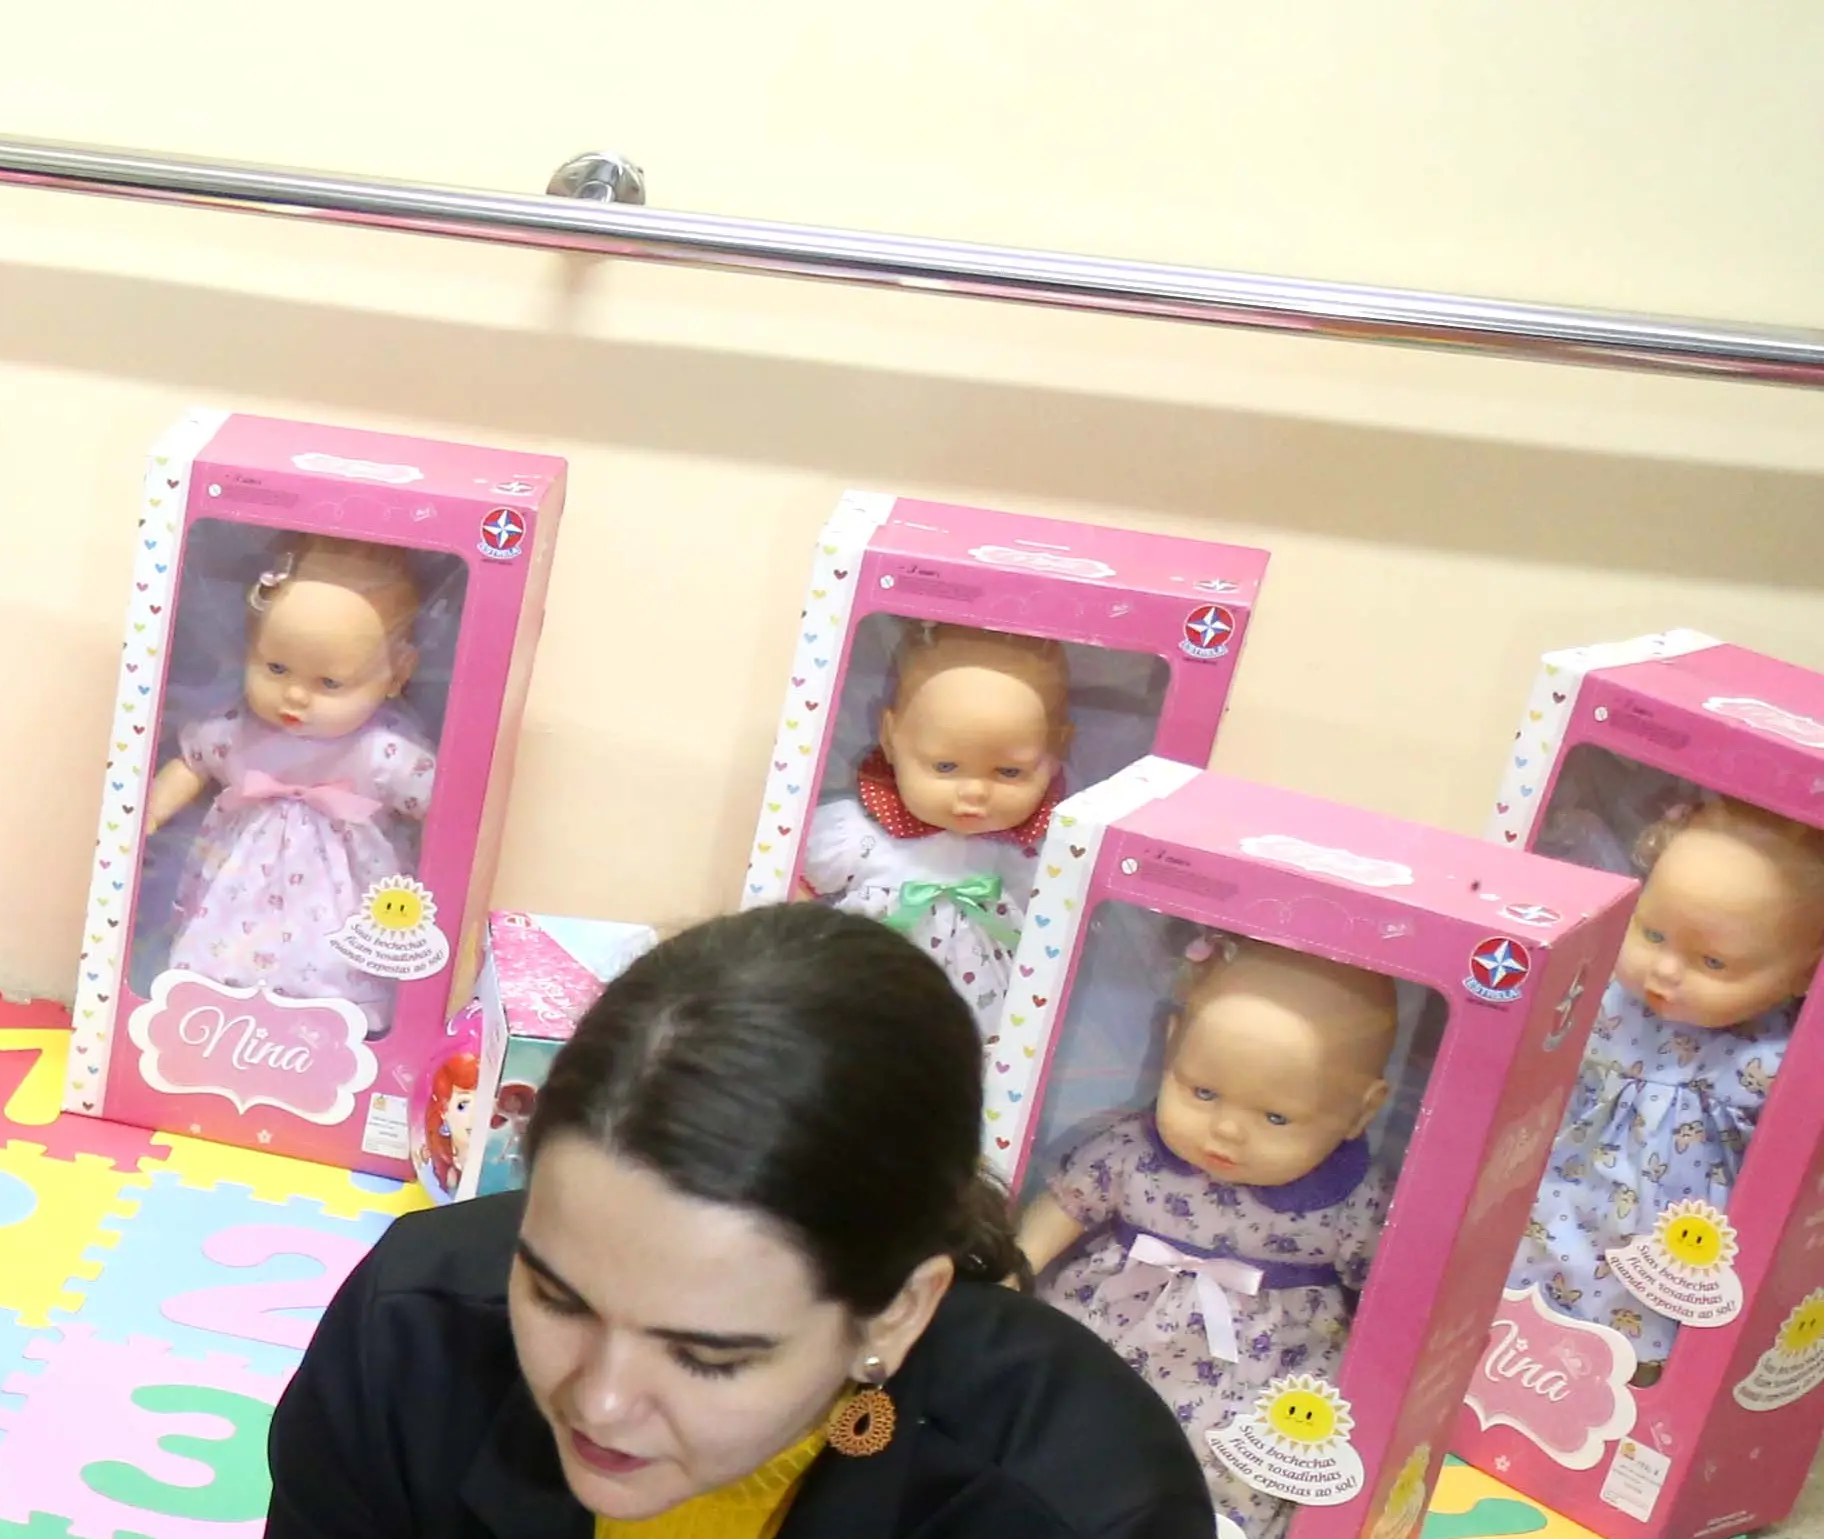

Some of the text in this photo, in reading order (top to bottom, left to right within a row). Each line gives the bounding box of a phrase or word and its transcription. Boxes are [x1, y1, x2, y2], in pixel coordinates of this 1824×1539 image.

[351, 923, 427, 952] Suas bochechas
[367, 958, 411, 974] expostas
[179, 1005, 314, 1075] Nina
[1609, 1254, 1736, 1320] quando expostas ao sol!
[1626, 1256, 1723, 1305] ficam rosadinhas
[1636, 1243, 1721, 1292] Suas bochechas
[79, 1383, 274, 1523] 3
[1210, 1437, 1358, 1498] quando expostas ao sol!
[1229, 1438, 1342, 1483] ficam rosadinhas
[1239, 1424, 1337, 1469] Suas bochechas
